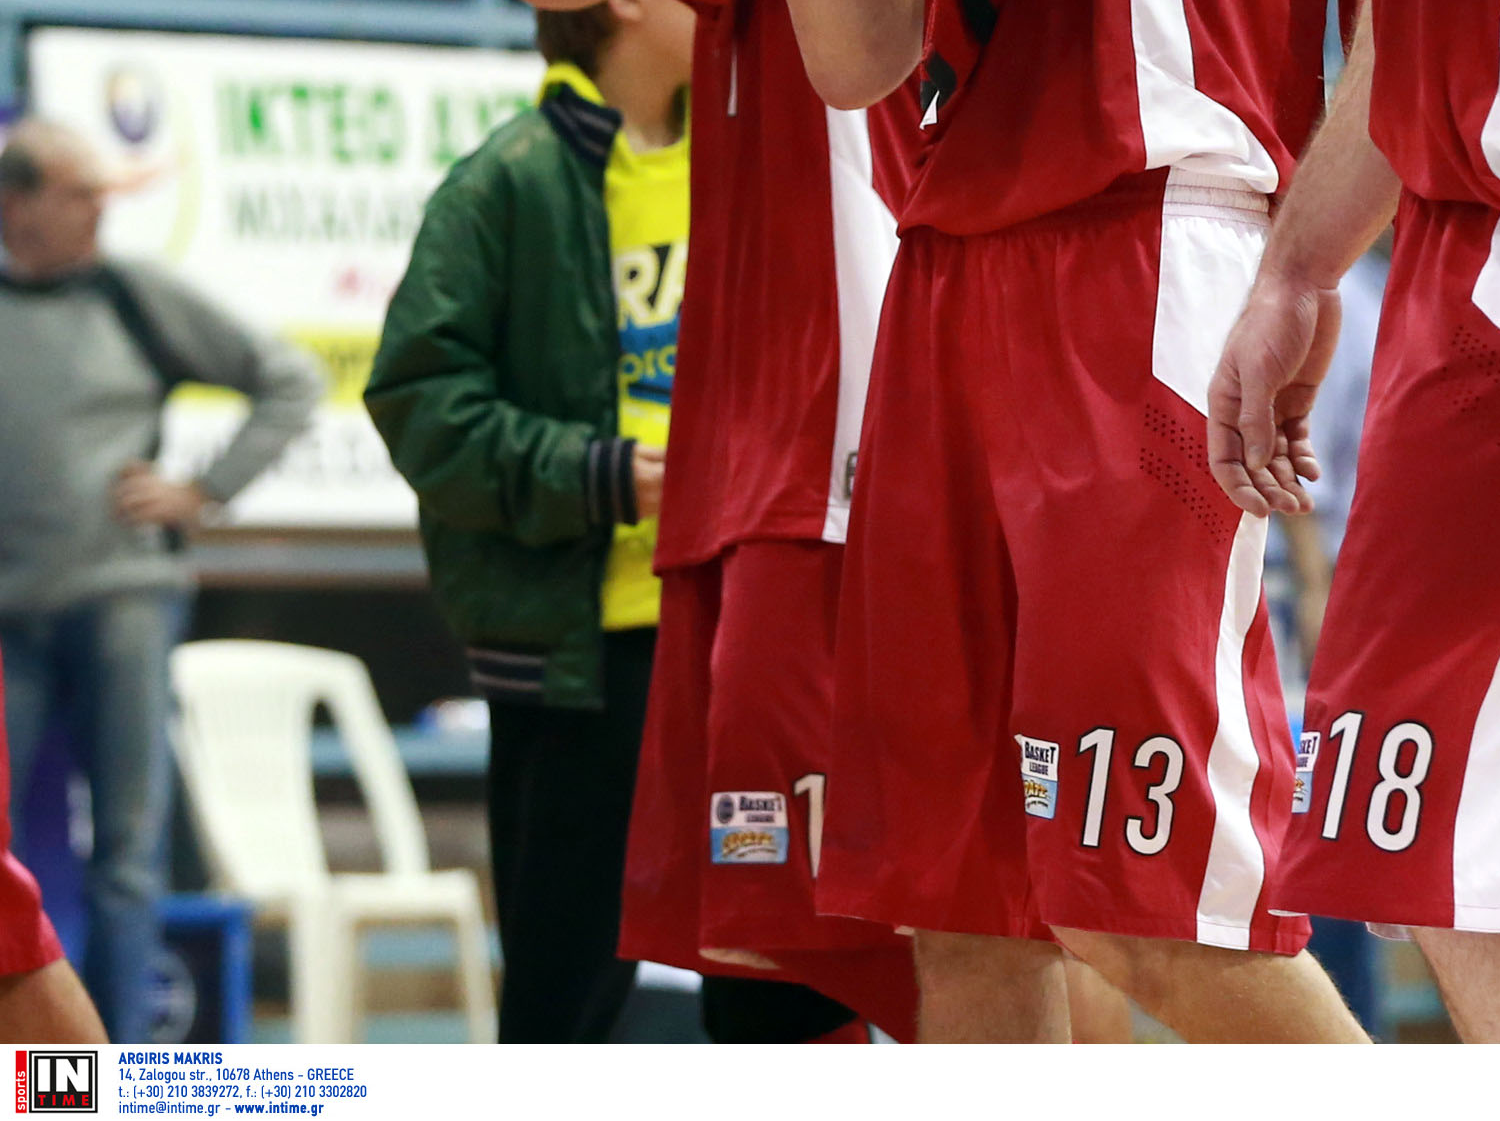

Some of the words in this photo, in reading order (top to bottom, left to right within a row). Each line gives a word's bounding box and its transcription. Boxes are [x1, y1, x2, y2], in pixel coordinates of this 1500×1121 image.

[1025, 741, 1056, 764] BASKET
[1077, 727, 1185, 856] 13
[1320, 710, 1434, 853] 18
